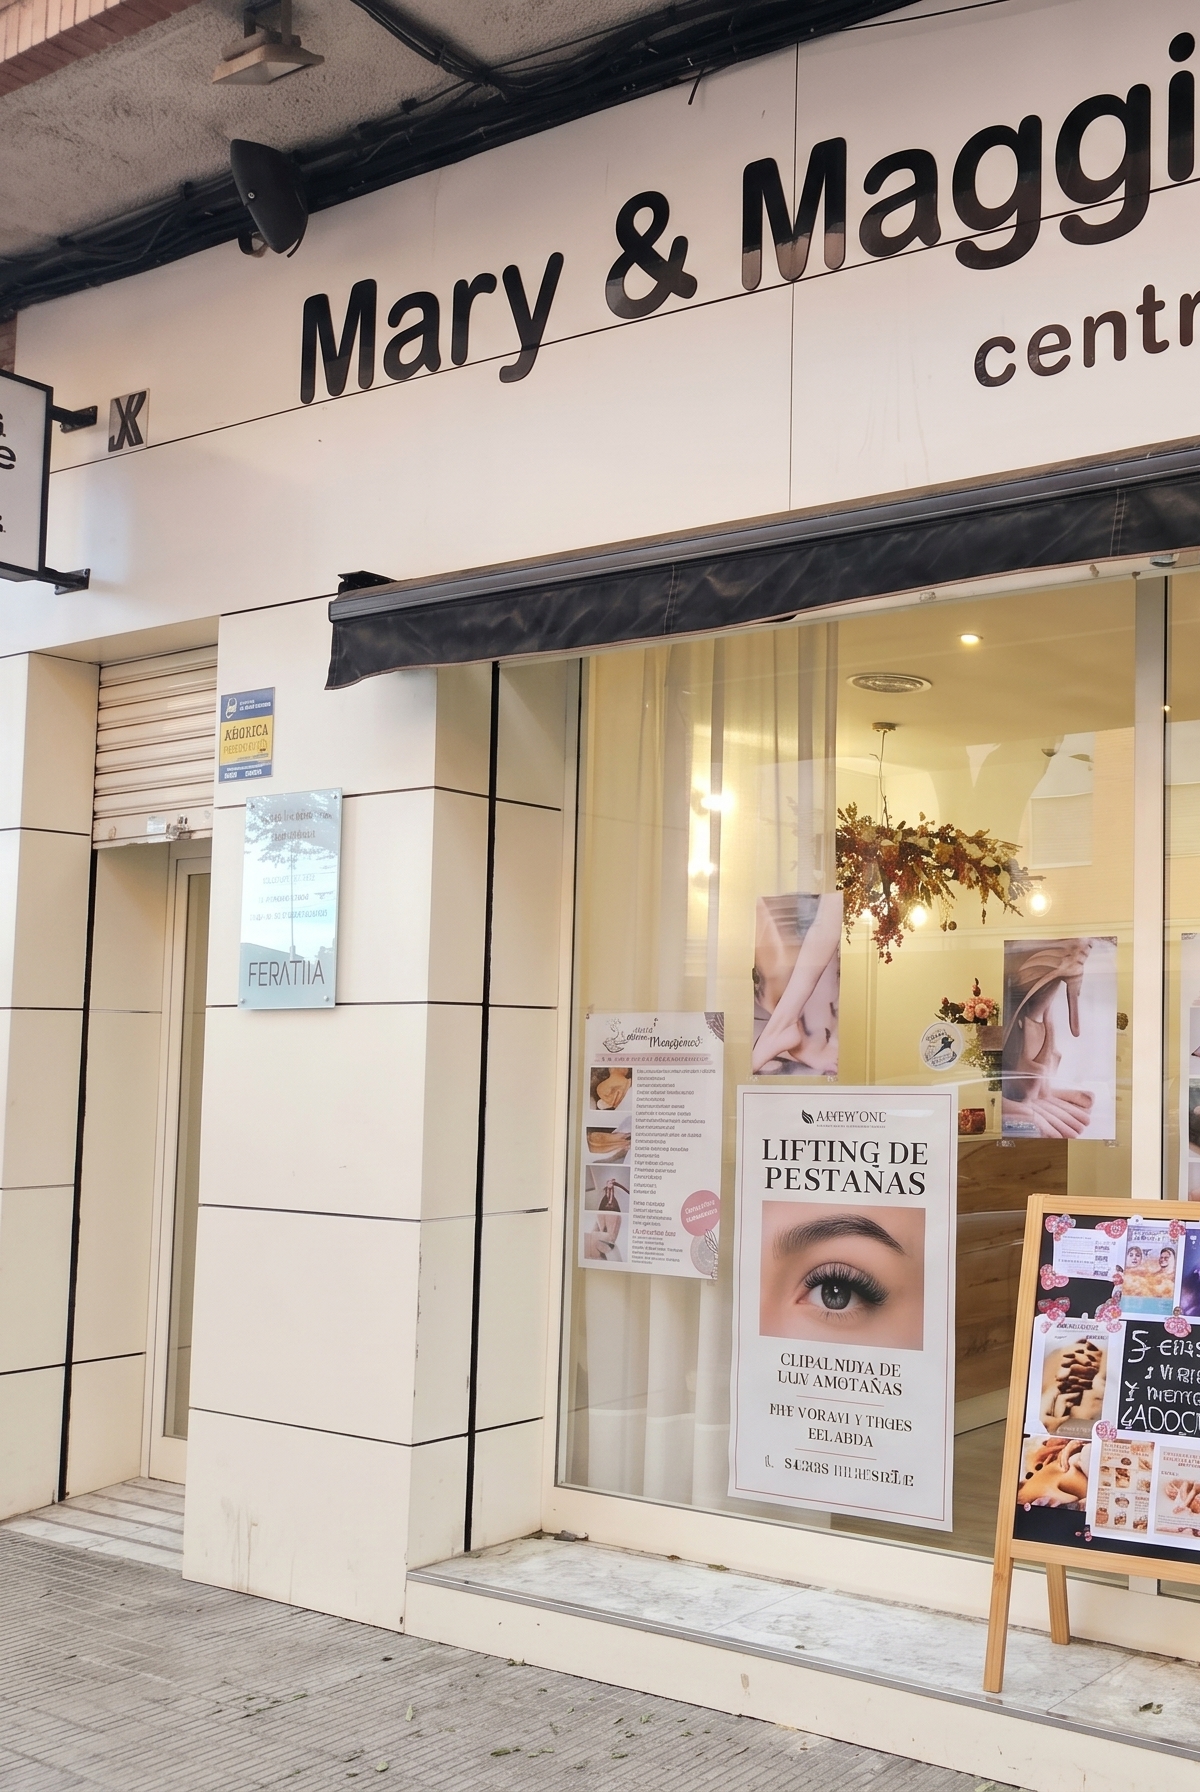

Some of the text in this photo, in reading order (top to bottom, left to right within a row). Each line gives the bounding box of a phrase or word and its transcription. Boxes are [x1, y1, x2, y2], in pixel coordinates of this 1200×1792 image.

[301, 251, 563, 404] Mary
[606, 191, 697, 319] &
[762, 1138, 928, 1165] LIFTING DE
[764, 1165, 926, 1195] PESTAÑAS
[879, 1362, 901, 1377] DE
